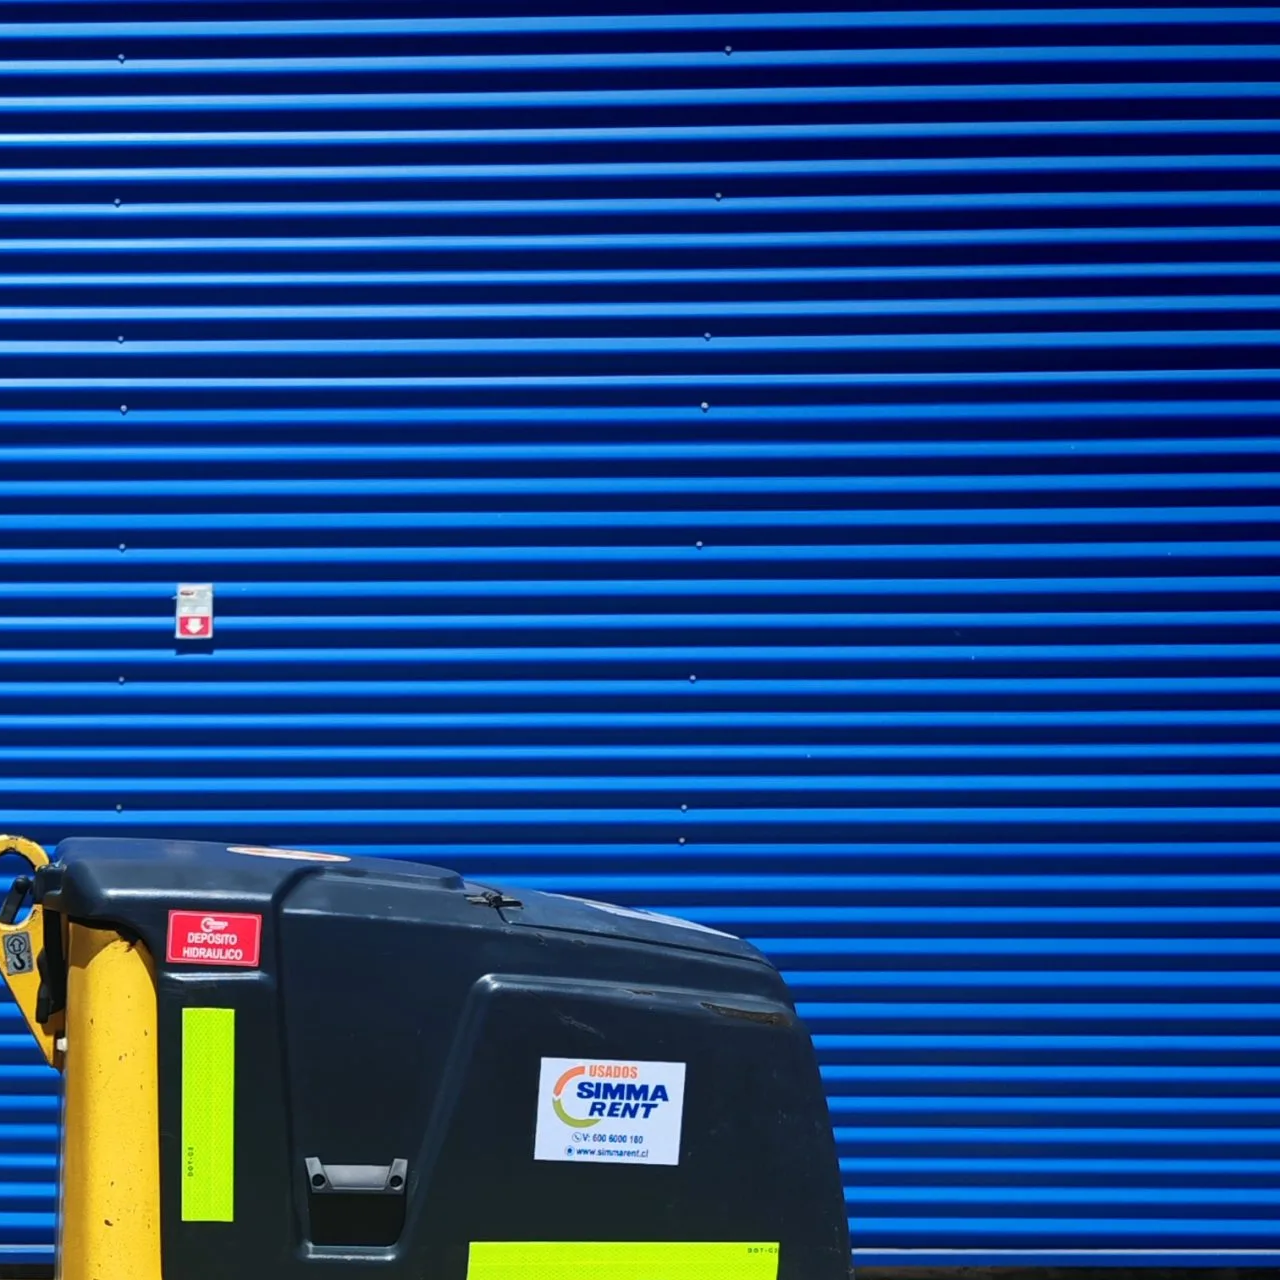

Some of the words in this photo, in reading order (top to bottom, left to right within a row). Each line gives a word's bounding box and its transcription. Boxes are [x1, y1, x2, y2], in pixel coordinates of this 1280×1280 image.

[187, 932, 238, 945] DEPOSITO
[182, 947, 243, 960] HIDRAULICO
[589, 1065, 638, 1079] USADOS
[576, 1081, 669, 1102] SIMMA
[588, 1101, 659, 1119] RENT
[576, 1148, 649, 1158] www.simmarent.cl
